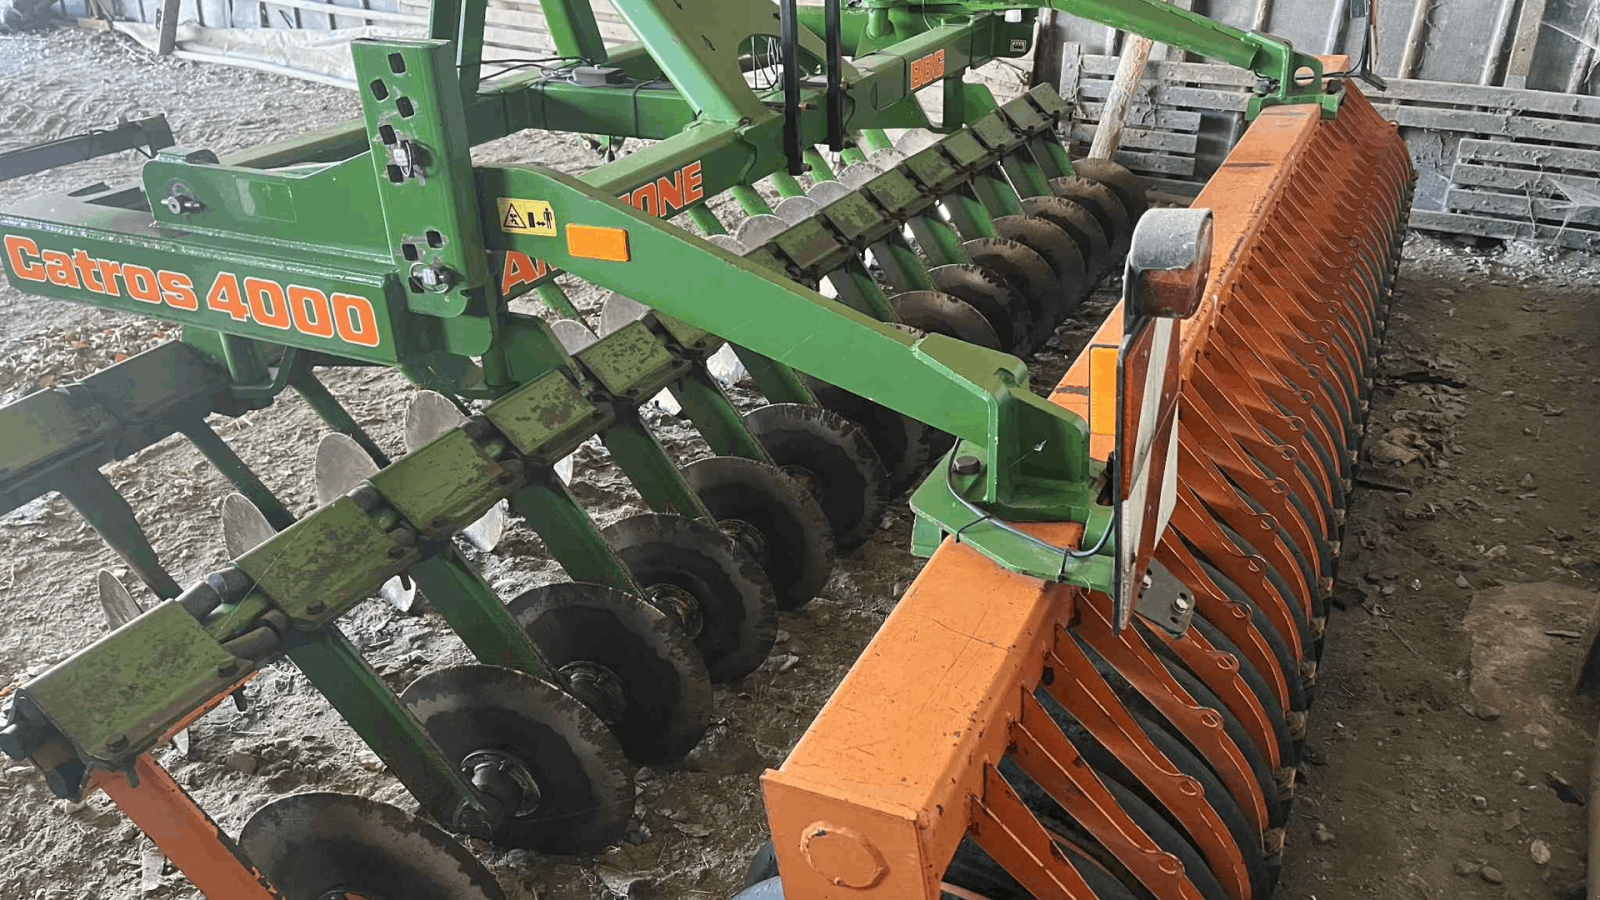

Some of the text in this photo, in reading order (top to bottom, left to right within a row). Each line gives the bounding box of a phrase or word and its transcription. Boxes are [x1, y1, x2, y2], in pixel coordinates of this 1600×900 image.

[501, 160, 704, 296] AONE
[4, 234, 380, 347] Catros 4000
